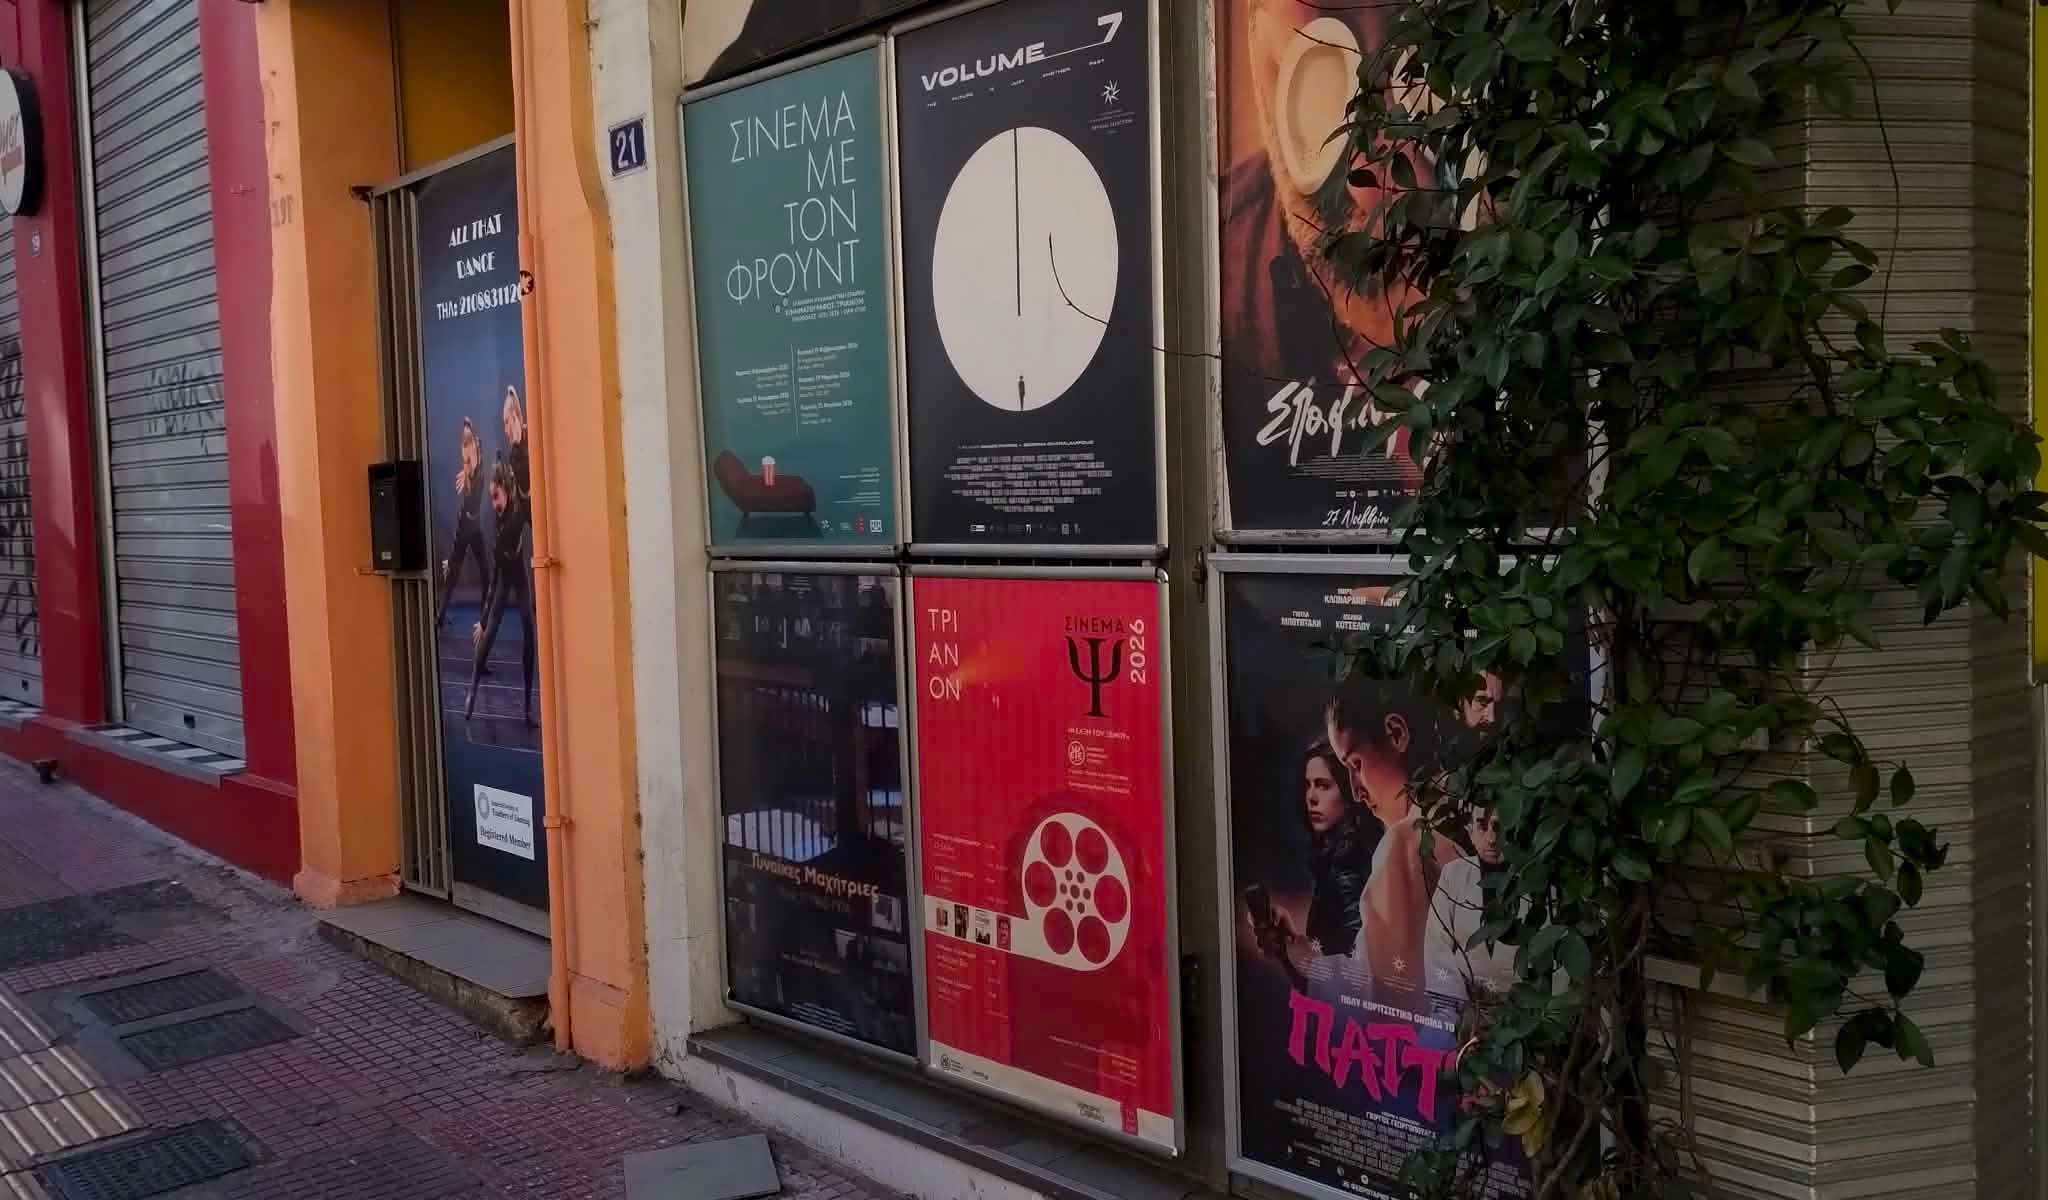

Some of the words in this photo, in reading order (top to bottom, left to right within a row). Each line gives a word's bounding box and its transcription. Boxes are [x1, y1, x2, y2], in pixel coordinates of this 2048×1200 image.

[921, 42, 1045, 91] VOLUME
[1097, 11, 1123, 43] 7
[730, 90, 856, 163] ΣΙΝΕΜΑ
[615, 127, 638, 168] 21
[807, 139, 856, 193] ΜΕ
[448, 225, 470, 248] ALL
[472, 213, 502, 241] THAT
[784, 189, 857, 244] ΤΟΝ
[456, 251, 496, 279] DANCE
[727, 239, 860, 305] ΦΡΟΥΝΤ
[1322, 508, 1341, 526] 27
[928, 608, 958, 633] ΤΡΙ
[1064, 615, 1126, 634] ΣΙΝΕΜΑ
[928, 642, 960, 667] ΑΝ
[1129, 618, 1147, 685] 2026
[929, 676, 961, 701] ΟΝ
[805, 866, 880, 903] Μαχήτριες
[1288, 989, 1457, 1122] ΠΑΤΤ
